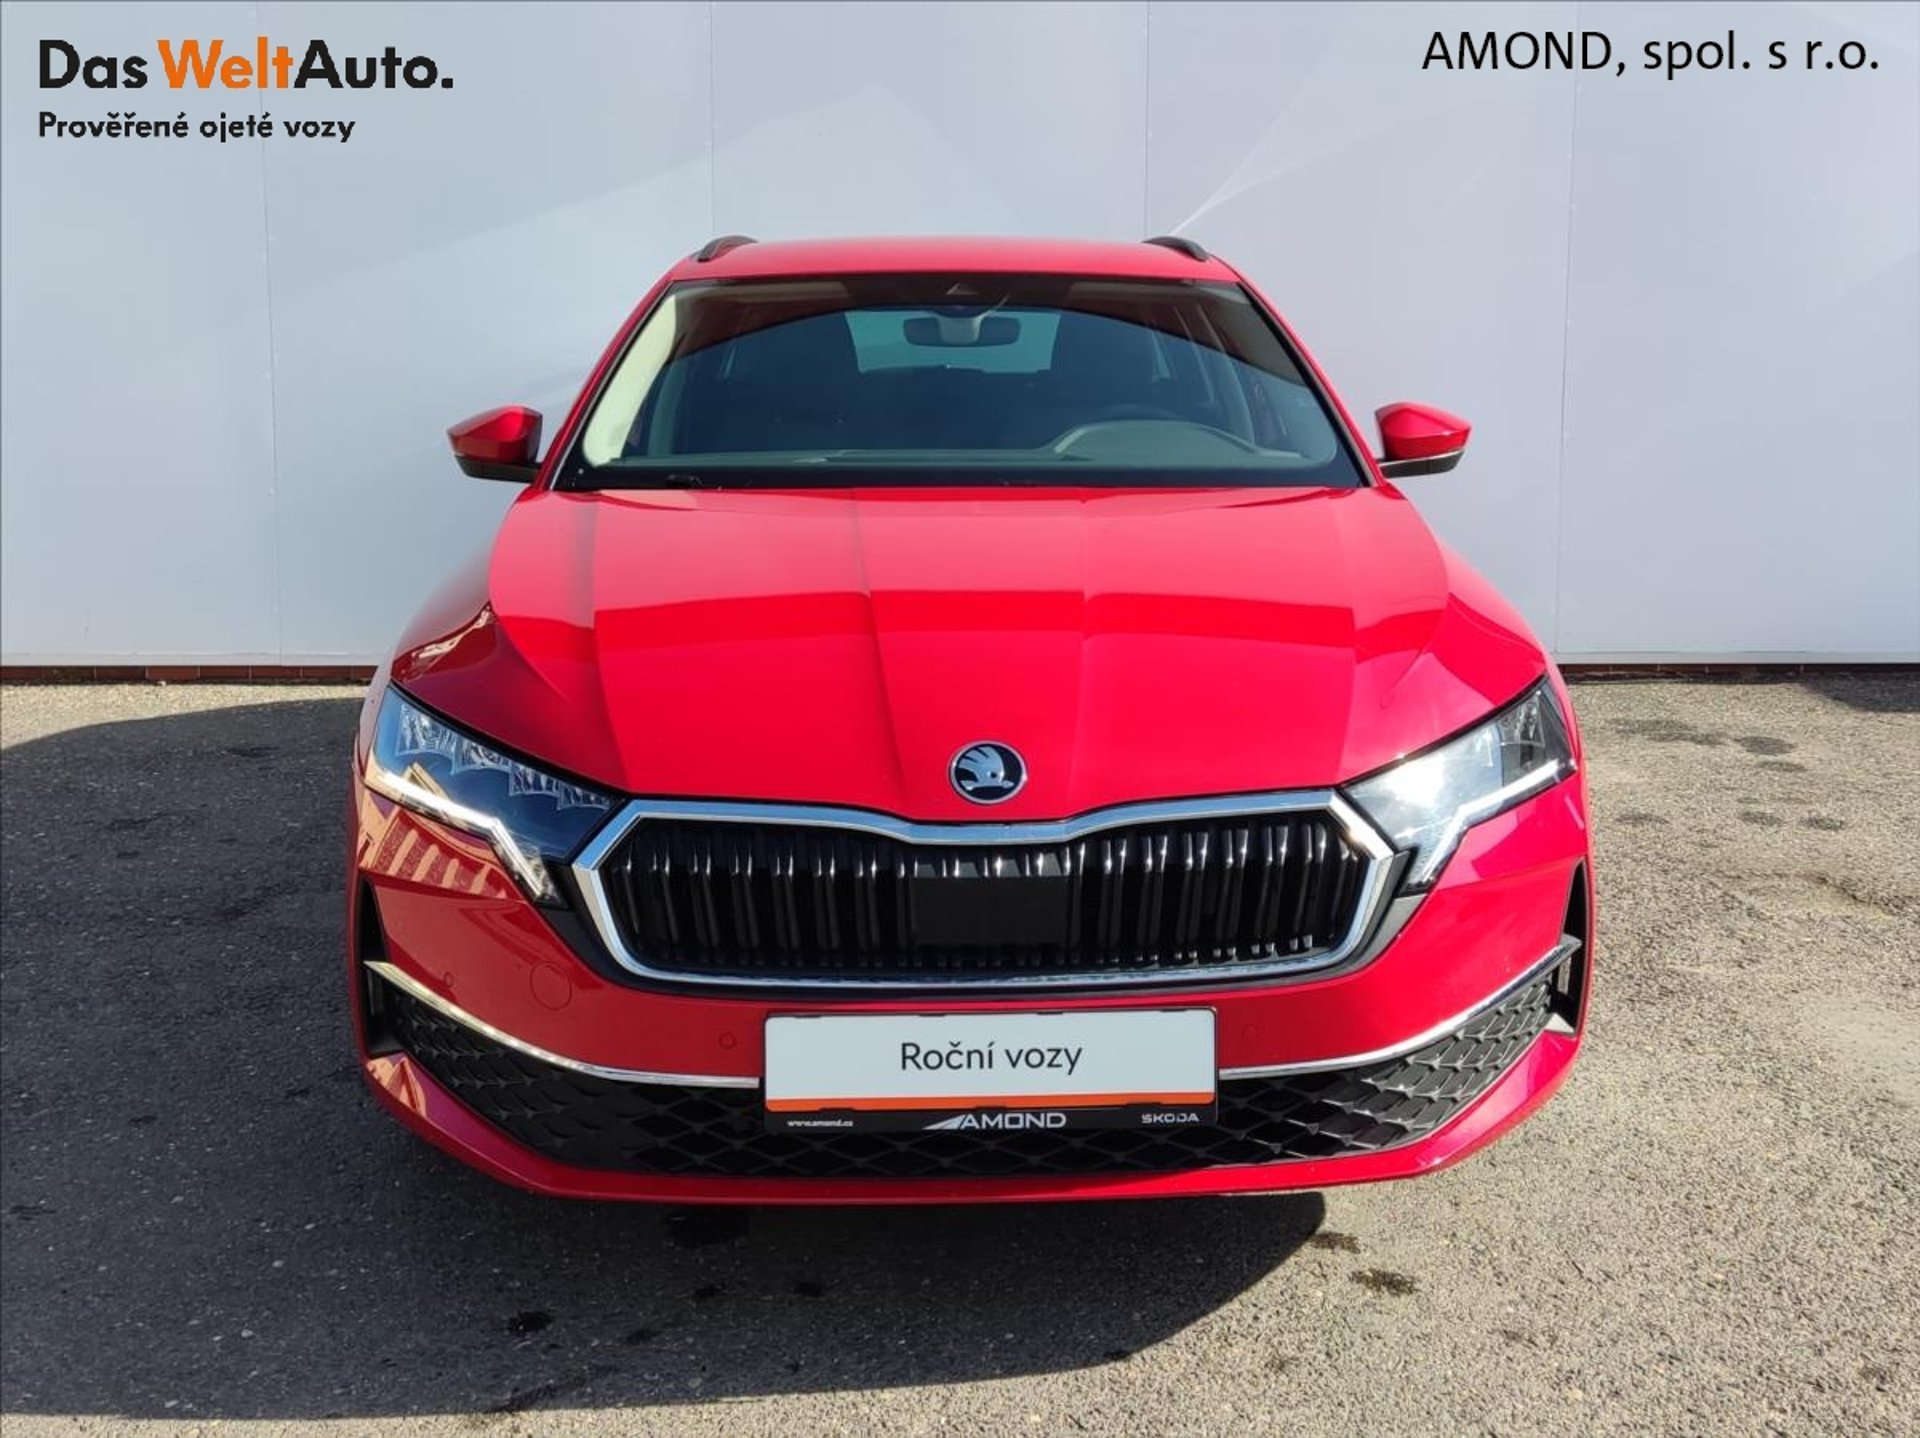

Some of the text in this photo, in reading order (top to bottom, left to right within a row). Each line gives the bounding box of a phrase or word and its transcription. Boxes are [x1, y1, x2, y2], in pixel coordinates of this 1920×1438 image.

[900, 1041, 1084, 1076] Roční vozy
[956, 1112, 1068, 1130] AMOND
